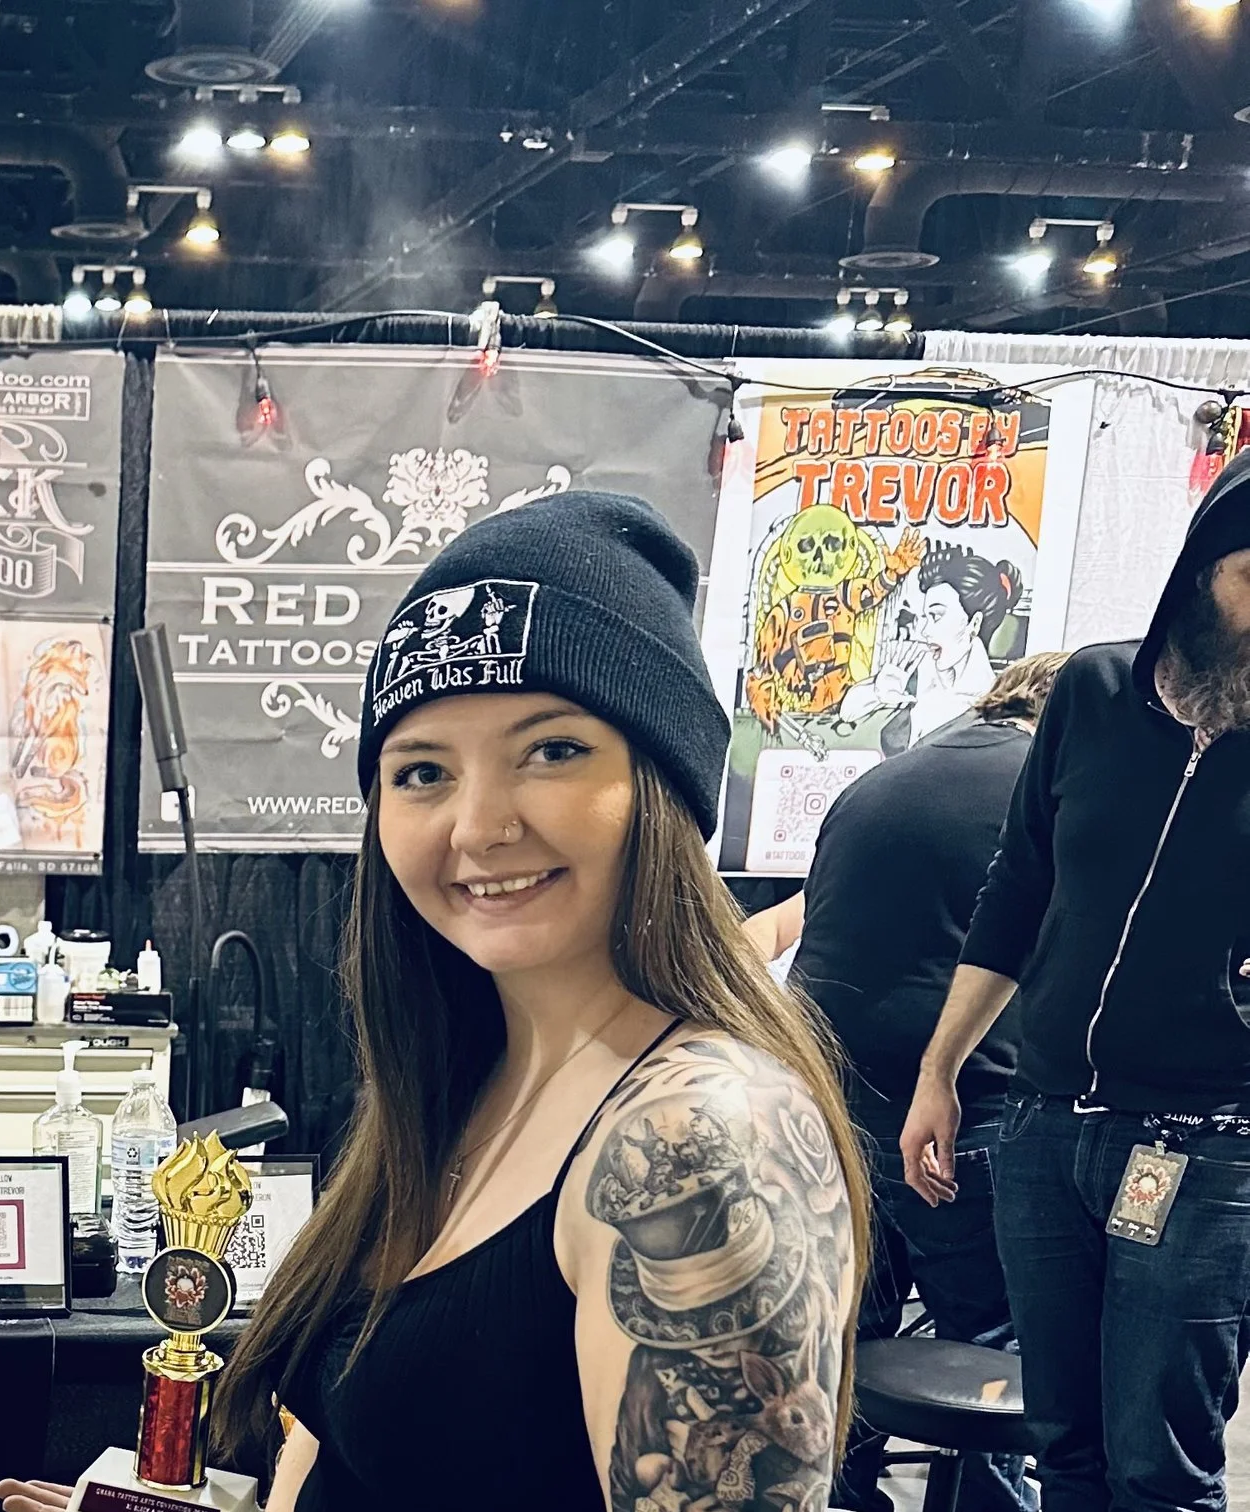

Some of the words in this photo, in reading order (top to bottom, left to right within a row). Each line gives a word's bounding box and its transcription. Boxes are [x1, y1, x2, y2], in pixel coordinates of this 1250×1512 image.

[3, 392, 71, 410] ARBOR
[781, 407, 961, 456] TATTOOS
[968, 411, 1021, 459] BY
[793, 459, 1012, 529] TREVOR
[201, 577, 361, 627] RED
[178, 634, 377, 666] TATTOOS
[373, 678, 424, 727] Heaven
[427, 664, 474, 690] Was
[476, 658, 526, 685] Full
[38, 862, 55, 872] SD
[117, 1490, 139, 1502] TATTOO
